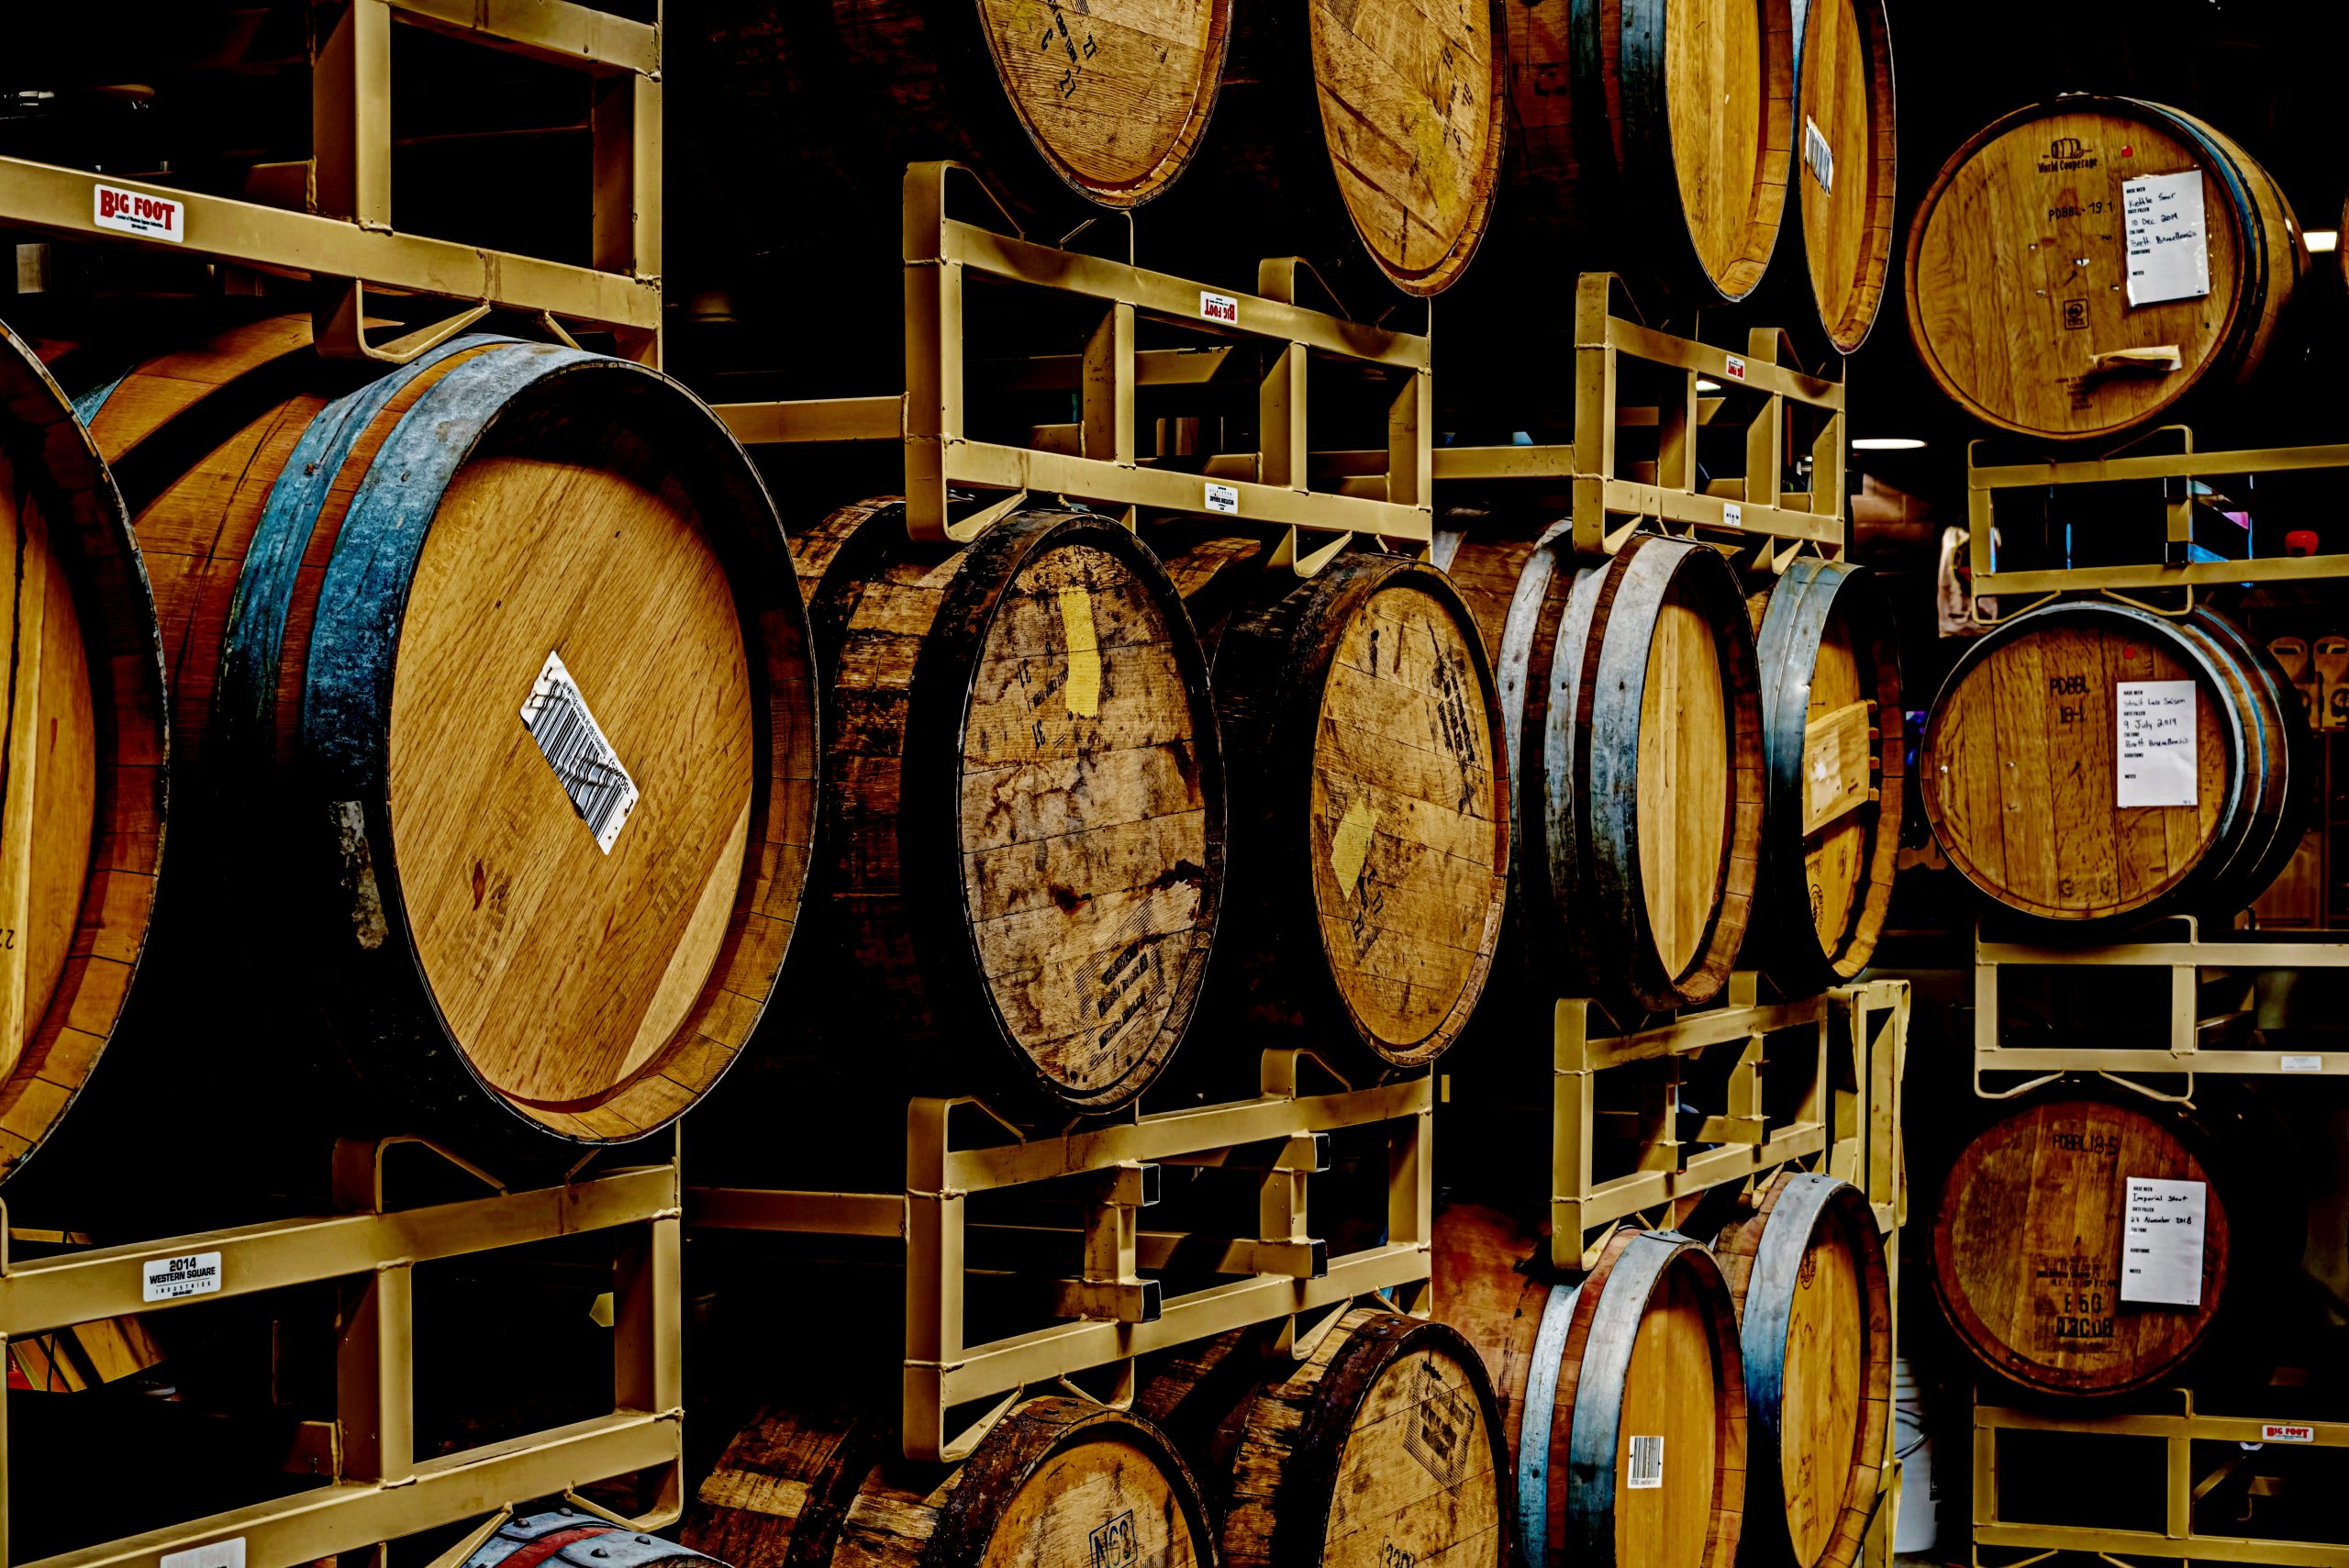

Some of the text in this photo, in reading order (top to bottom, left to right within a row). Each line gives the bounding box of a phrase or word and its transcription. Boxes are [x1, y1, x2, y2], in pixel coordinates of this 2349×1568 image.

[2038, 158, 2098, 173] World Cooperage
[2128, 196, 2153, 208] Kettle
[100, 189, 129, 217] BIG
[135, 196, 175, 230] FOOT
[2142, 217, 2155, 226] Dec
[1204, 298, 1221, 317] FOOT
[1223, 304, 1235, 321] BIG
[2134, 719, 2153, 730] July
[2156, 718, 2177, 728] 2019
[2132, 1193, 2163, 1203] Imperial
[169, 1257, 196, 1272] 2014
[150, 1266, 216, 1284] WESTERN SQUARE
[155, 1281, 211, 1294] INDUSTRIES
[2267, 1427, 2283, 1437] BIG
[2285, 1428, 2309, 1439] FOOT
